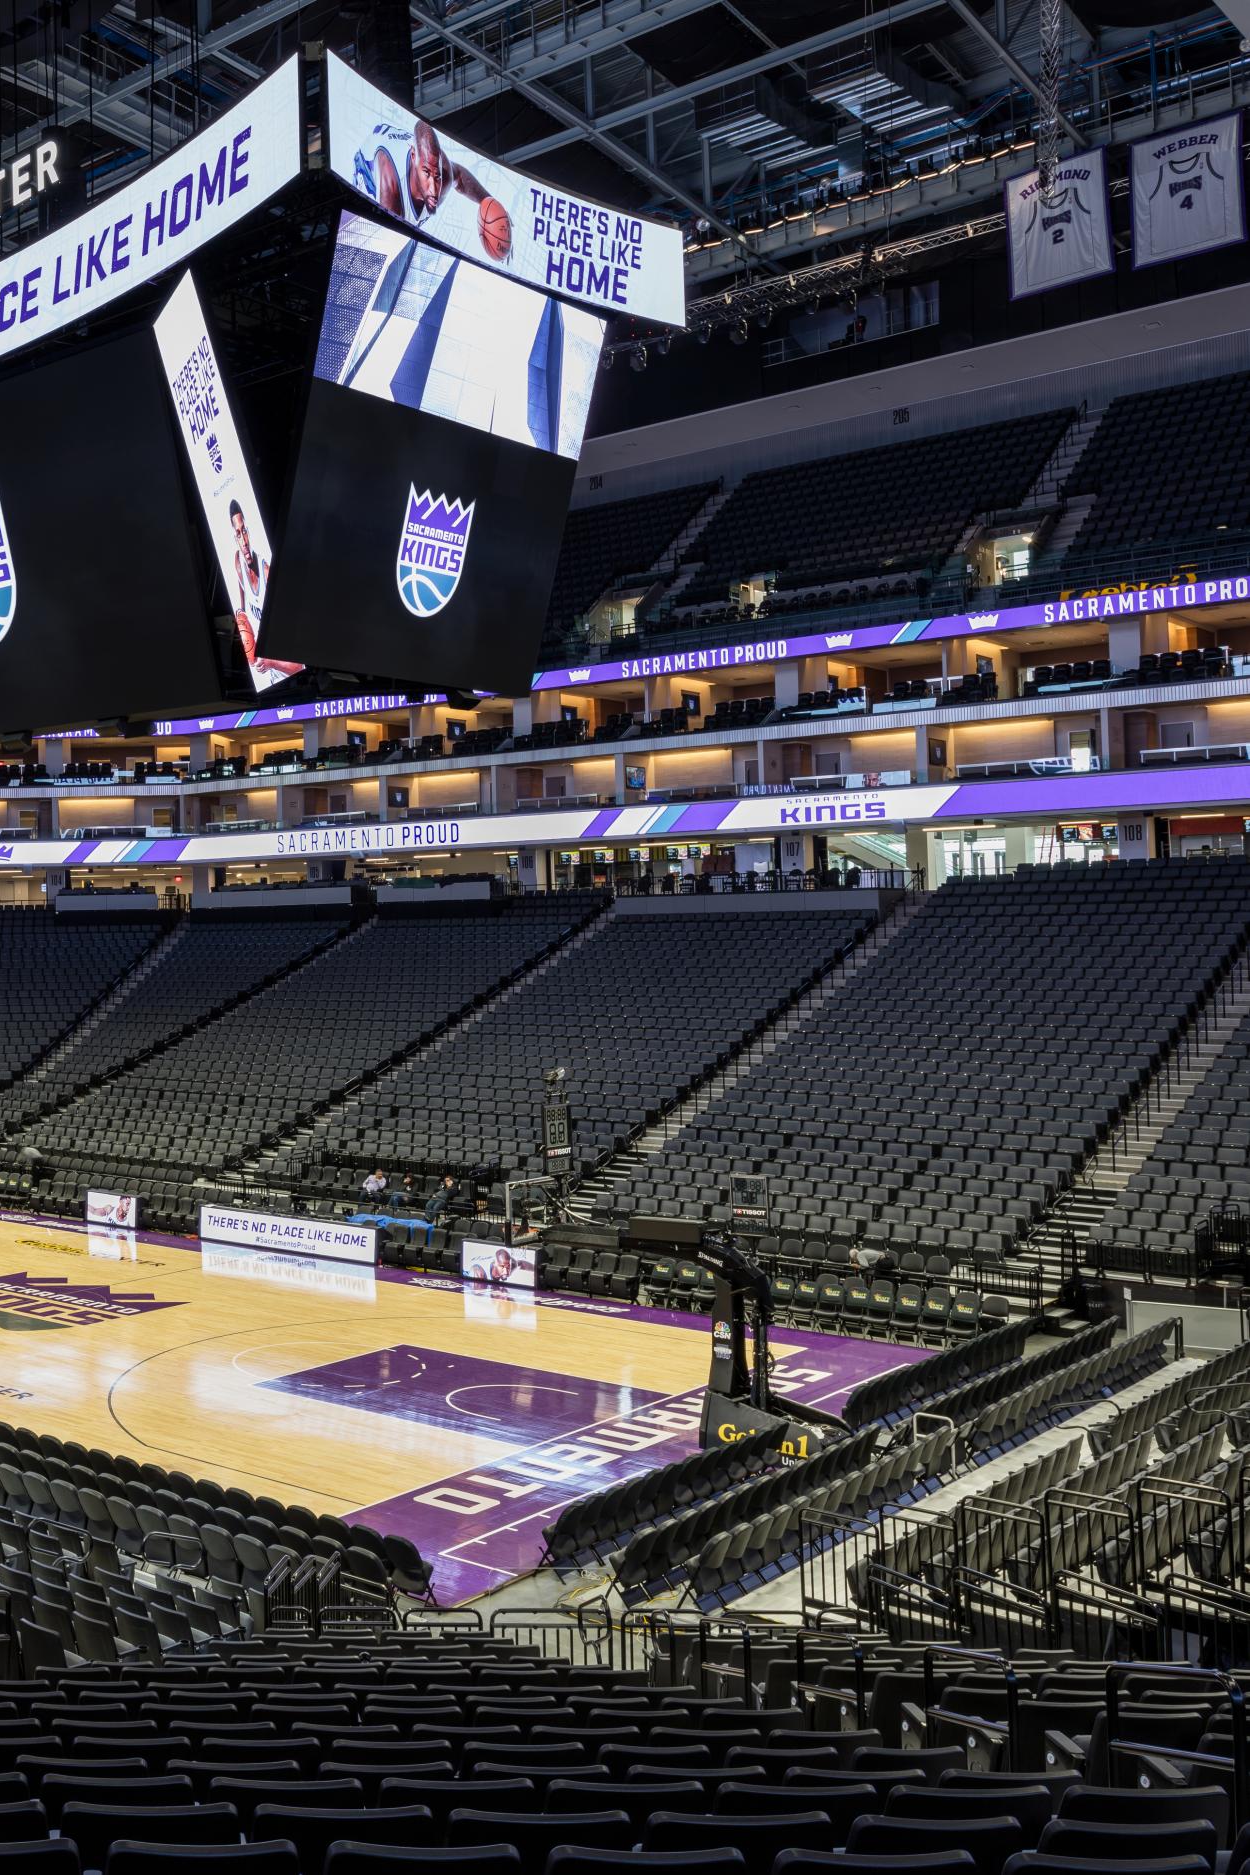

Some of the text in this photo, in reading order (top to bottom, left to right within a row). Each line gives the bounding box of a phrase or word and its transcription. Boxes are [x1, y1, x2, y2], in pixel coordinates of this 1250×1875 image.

[1152, 134, 1219, 160] WEBBER
[1019, 168, 1091, 200] RIMOND
[52, 213, 133, 305] LIKE
[141, 125, 253, 256] HOME
[530, 188, 642, 243] THERE'S NO
[1180, 193, 1194, 211] 4
[533, 215, 642, 270] PLACE LIKE
[1052, 228, 1065, 245] 2
[545, 252, 629, 304] HOME
[172, 335, 211, 400] THERE'S NO
[179, 356, 216, 420] PLACE LIKE
[188, 384, 220, 445] HOME
[408, 522, 464, 545] SACRAMENTO
[401, 538, 463, 573] KINGS
[1044, 585, 1195, 623] SACRAMENTO
[621, 640, 787, 678] SACRAMENTO PROUD
[786, 793, 879, 804] SACRAMENTO
[781, 802, 886, 824] KINGS
[277, 823, 460, 853] SACRAMENTO PROUD
[1123, 824, 1142, 841] 108
[785, 841, 800, 857] 107
[51, 875, 62, 886] 104
[742, 1208, 766, 1216] TISSOT
[208, 1215, 368, 1247] THERE'S NO PLACE LIKE HOME
[255, 1236, 316, 1251] #SacramentoProud
[697, 1251, 723, 1268] SPALDING
[713, 1330, 731, 1340] CSN
